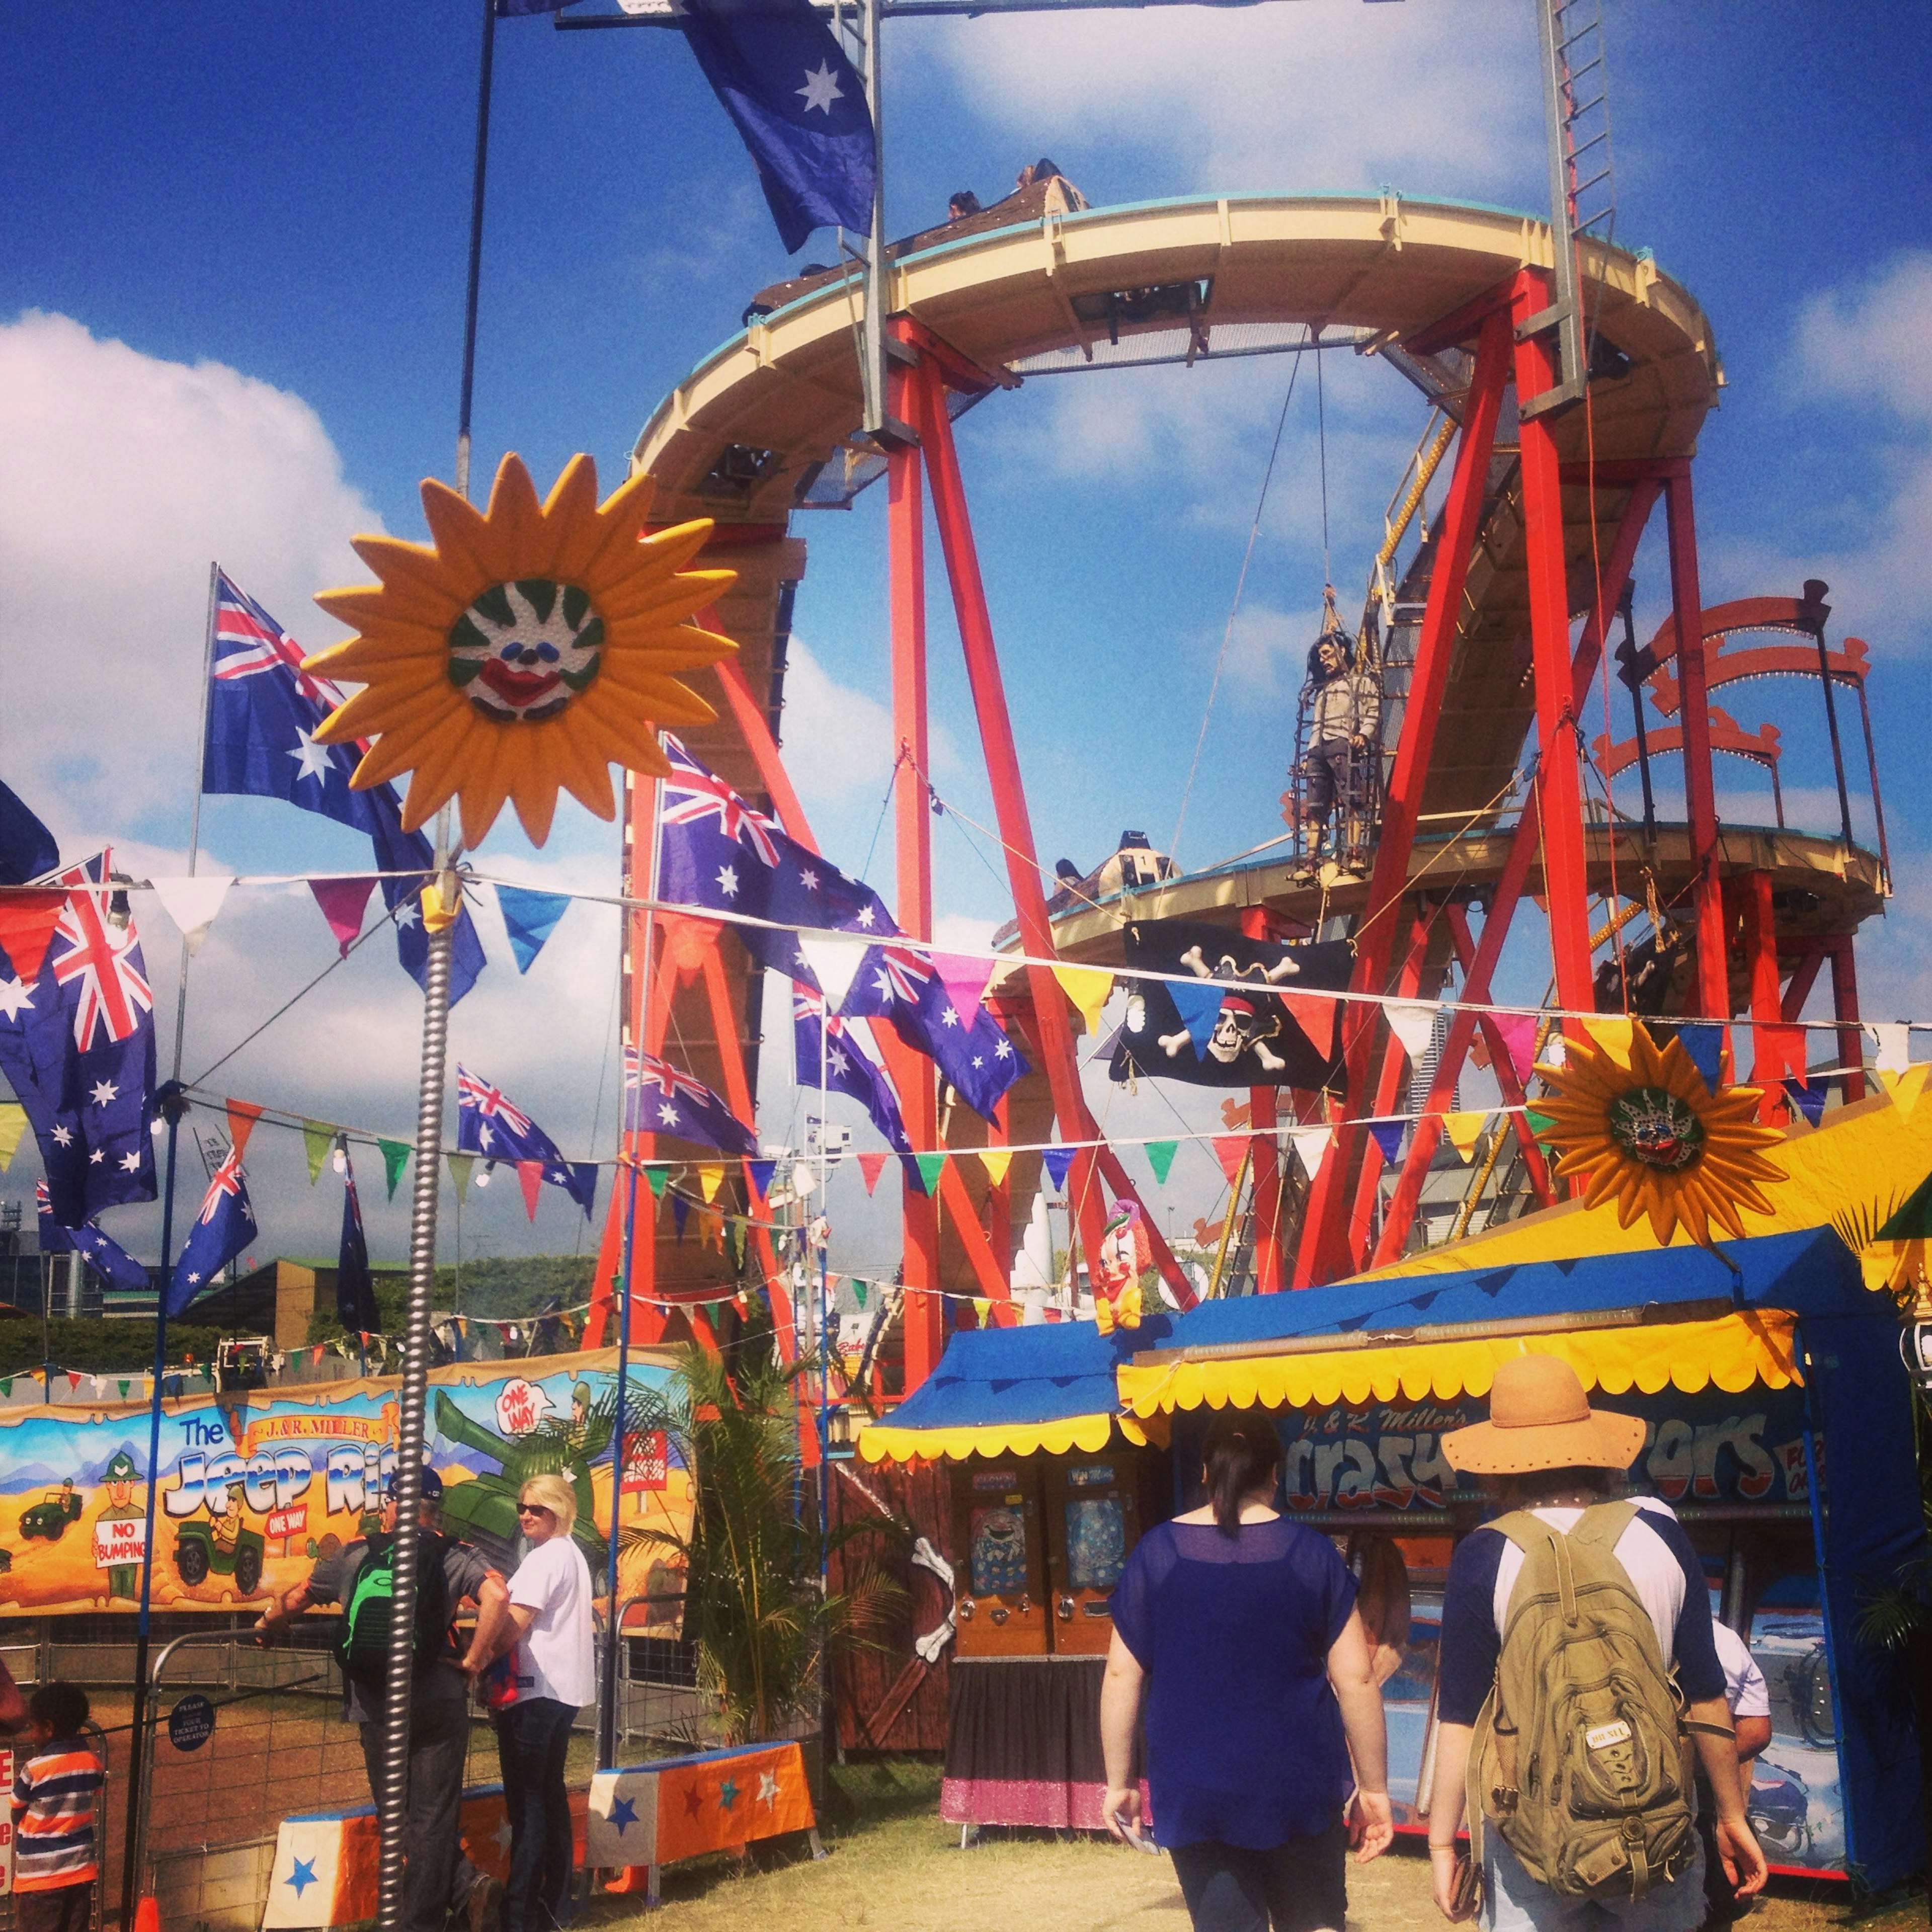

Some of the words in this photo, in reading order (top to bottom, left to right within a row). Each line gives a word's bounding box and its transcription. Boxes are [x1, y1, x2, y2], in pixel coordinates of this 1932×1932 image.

[502, 1384, 528, 1412] ONE
[508, 1402, 535, 1431] WAY
[1324, 1409, 1340, 1431] &
[1379, 1407, 1467, 1431] Miller's
[179, 1417, 224, 1445] The
[310, 1419, 369, 1438] MILLER
[164, 1446, 314, 1517] Jeep
[112, 1522, 135, 1538] NO
[270, 1514, 286, 1534] ONE
[286, 1509, 305, 1530] WAY
[98, 1542, 145, 1561] BUMPING
[179, 1702, 205, 1712] PLEASE
[173, 1731, 209, 1743] OPERATOR
[174, 1725, 199, 1735] TICKET
